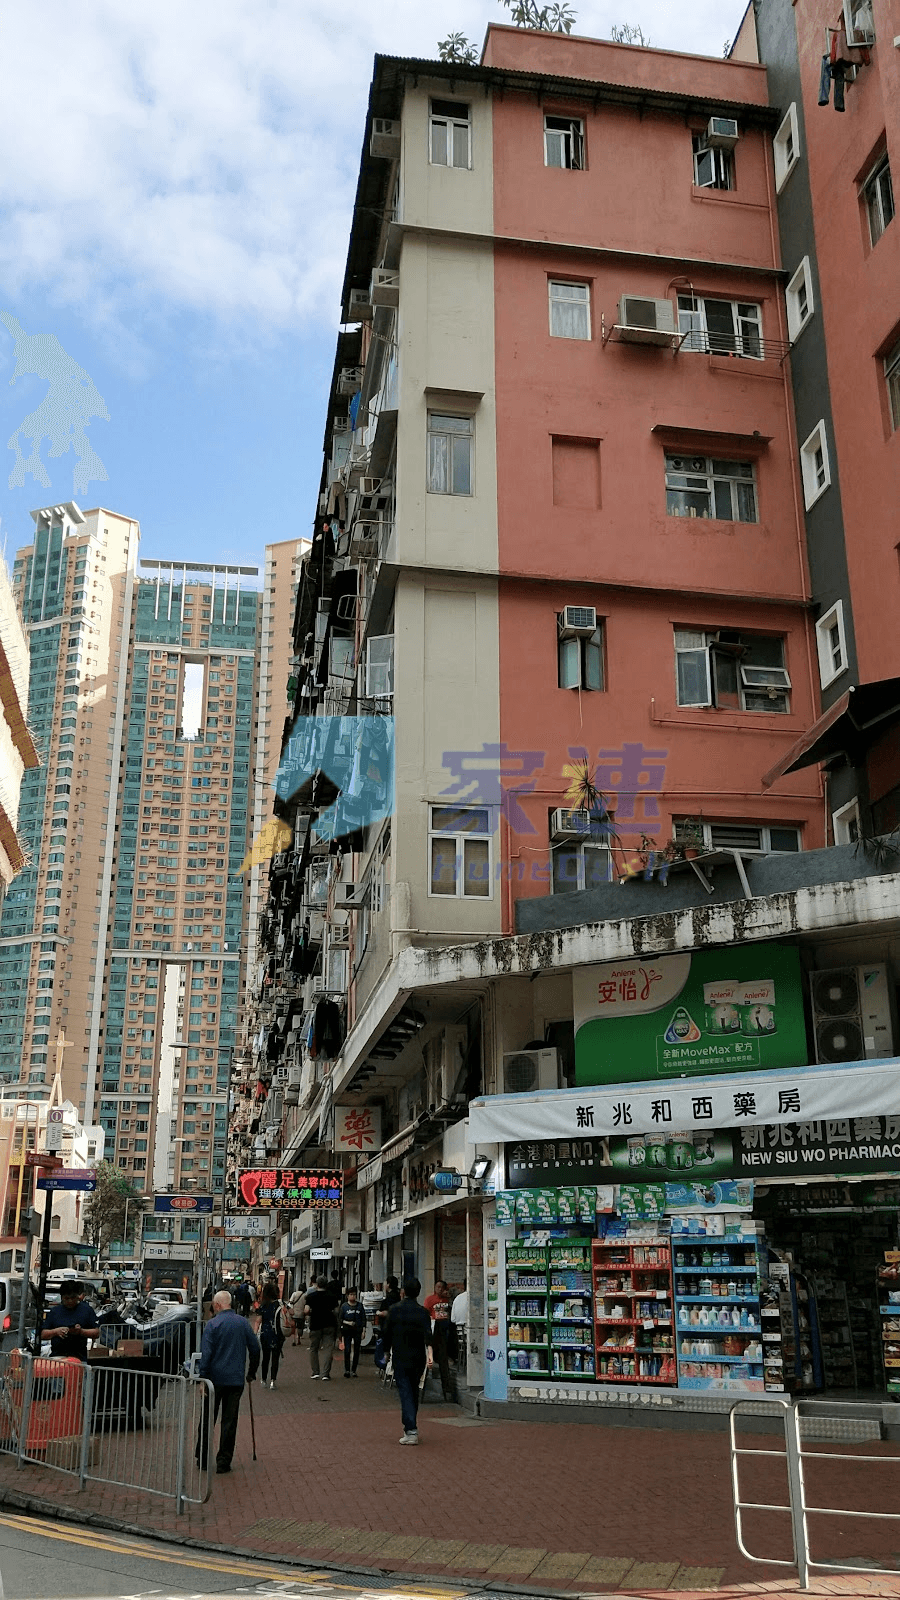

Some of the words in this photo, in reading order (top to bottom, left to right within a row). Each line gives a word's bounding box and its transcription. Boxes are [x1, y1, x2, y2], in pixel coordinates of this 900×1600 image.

[611, 969, 636, 978] Anlene
[598, 978, 638, 1003] 安怡
[576, 1088, 801, 1128] 新兆和西藥房
[741, 1152, 772, 1166] NEW
[775, 1150, 798, 1164] SIU
[801, 1148, 826, 1163] WO
[298, 1176, 340, 1189] 美容中心
[259, 1188, 284, 1199] 理療
[287, 1188, 312, 1199] 保健
[314, 1188, 340, 1199] 按摩
[274, 1198, 306, 1206] 3689
[308, 1198, 339, 1206] 9693
